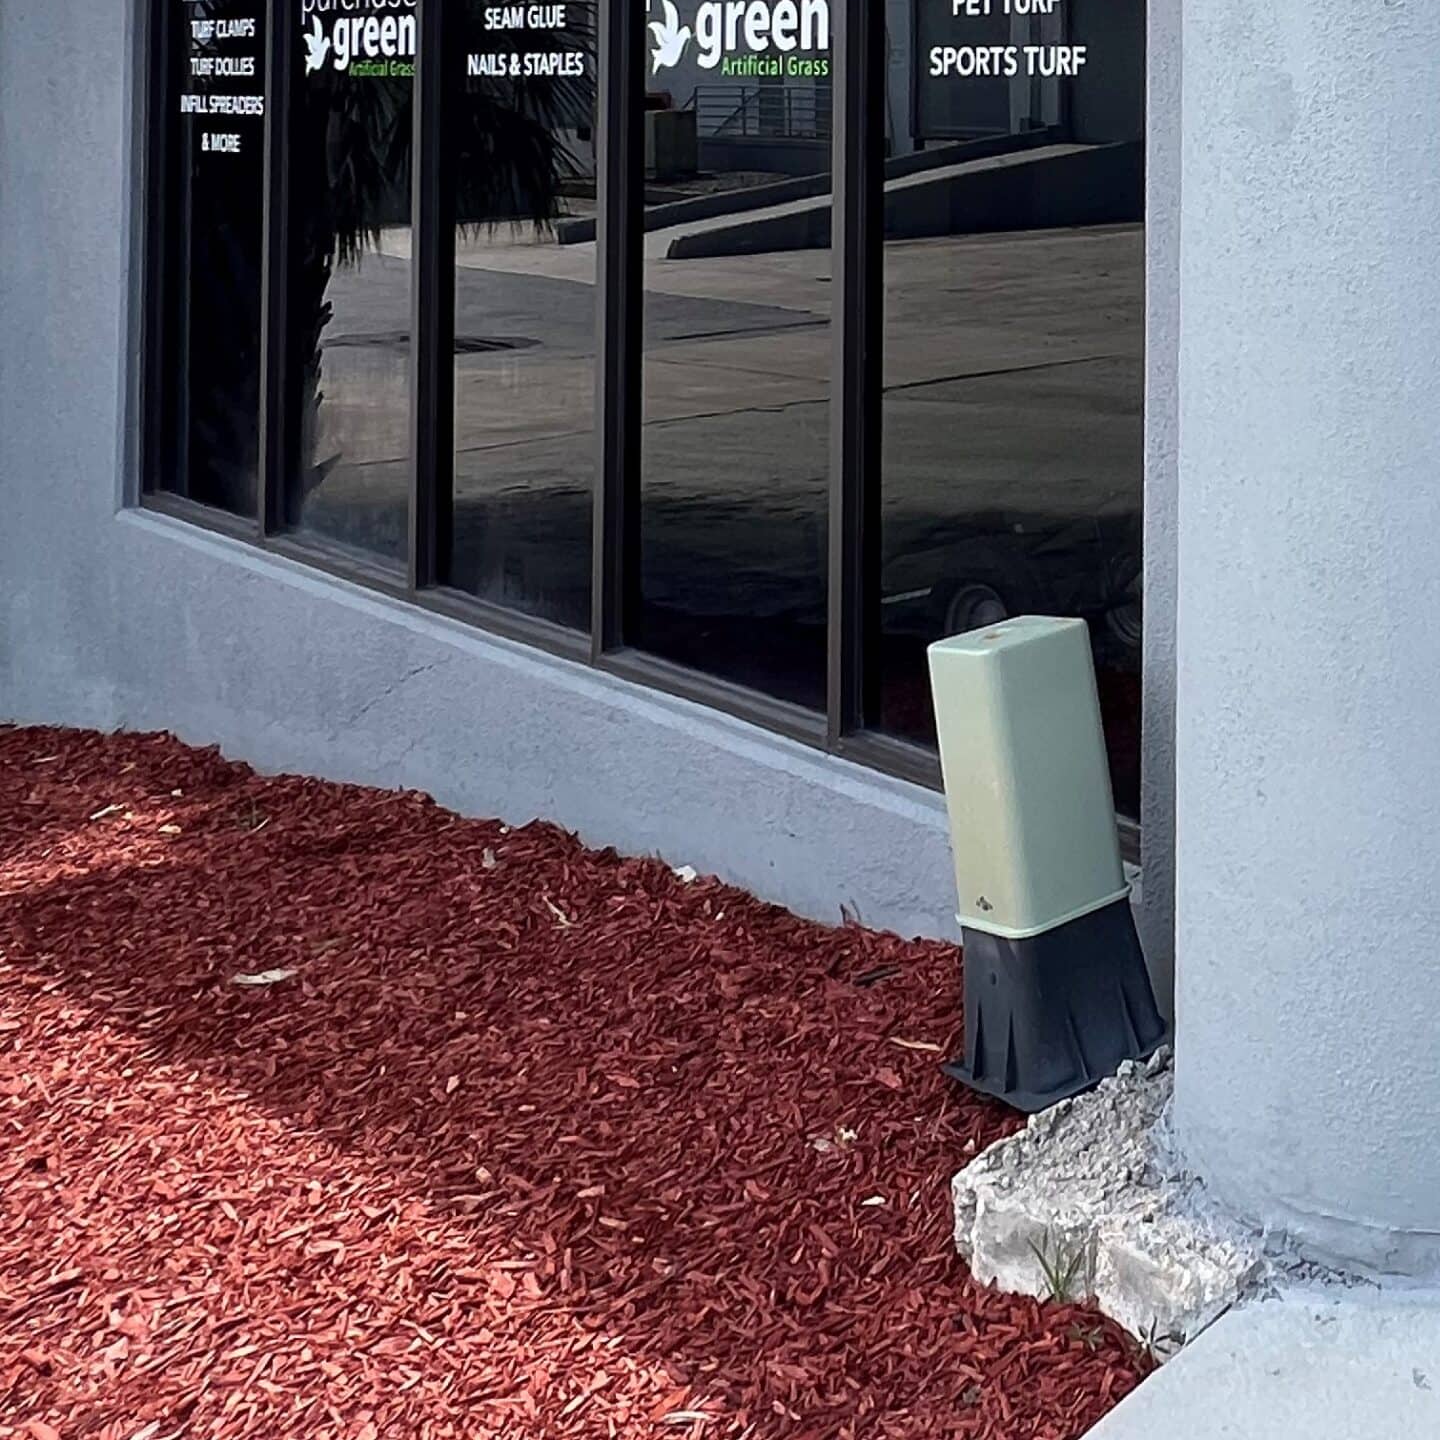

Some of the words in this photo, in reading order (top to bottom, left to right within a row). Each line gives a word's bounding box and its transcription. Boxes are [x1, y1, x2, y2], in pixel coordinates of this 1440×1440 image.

[484, 6, 525, 30] SEAM
[527, 4, 567, 29] GLUE
[333, 14, 417, 71] green
[467, 53, 507, 77] NAILS
[509, 52, 521, 76] &
[523, 51, 584, 77] STAPLES
[722, 55, 783, 76] Artificial
[787, 56, 829, 76] Grass
[929, 46, 1017, 76] SPORTS
[1023, 45, 1087, 76] TURF
